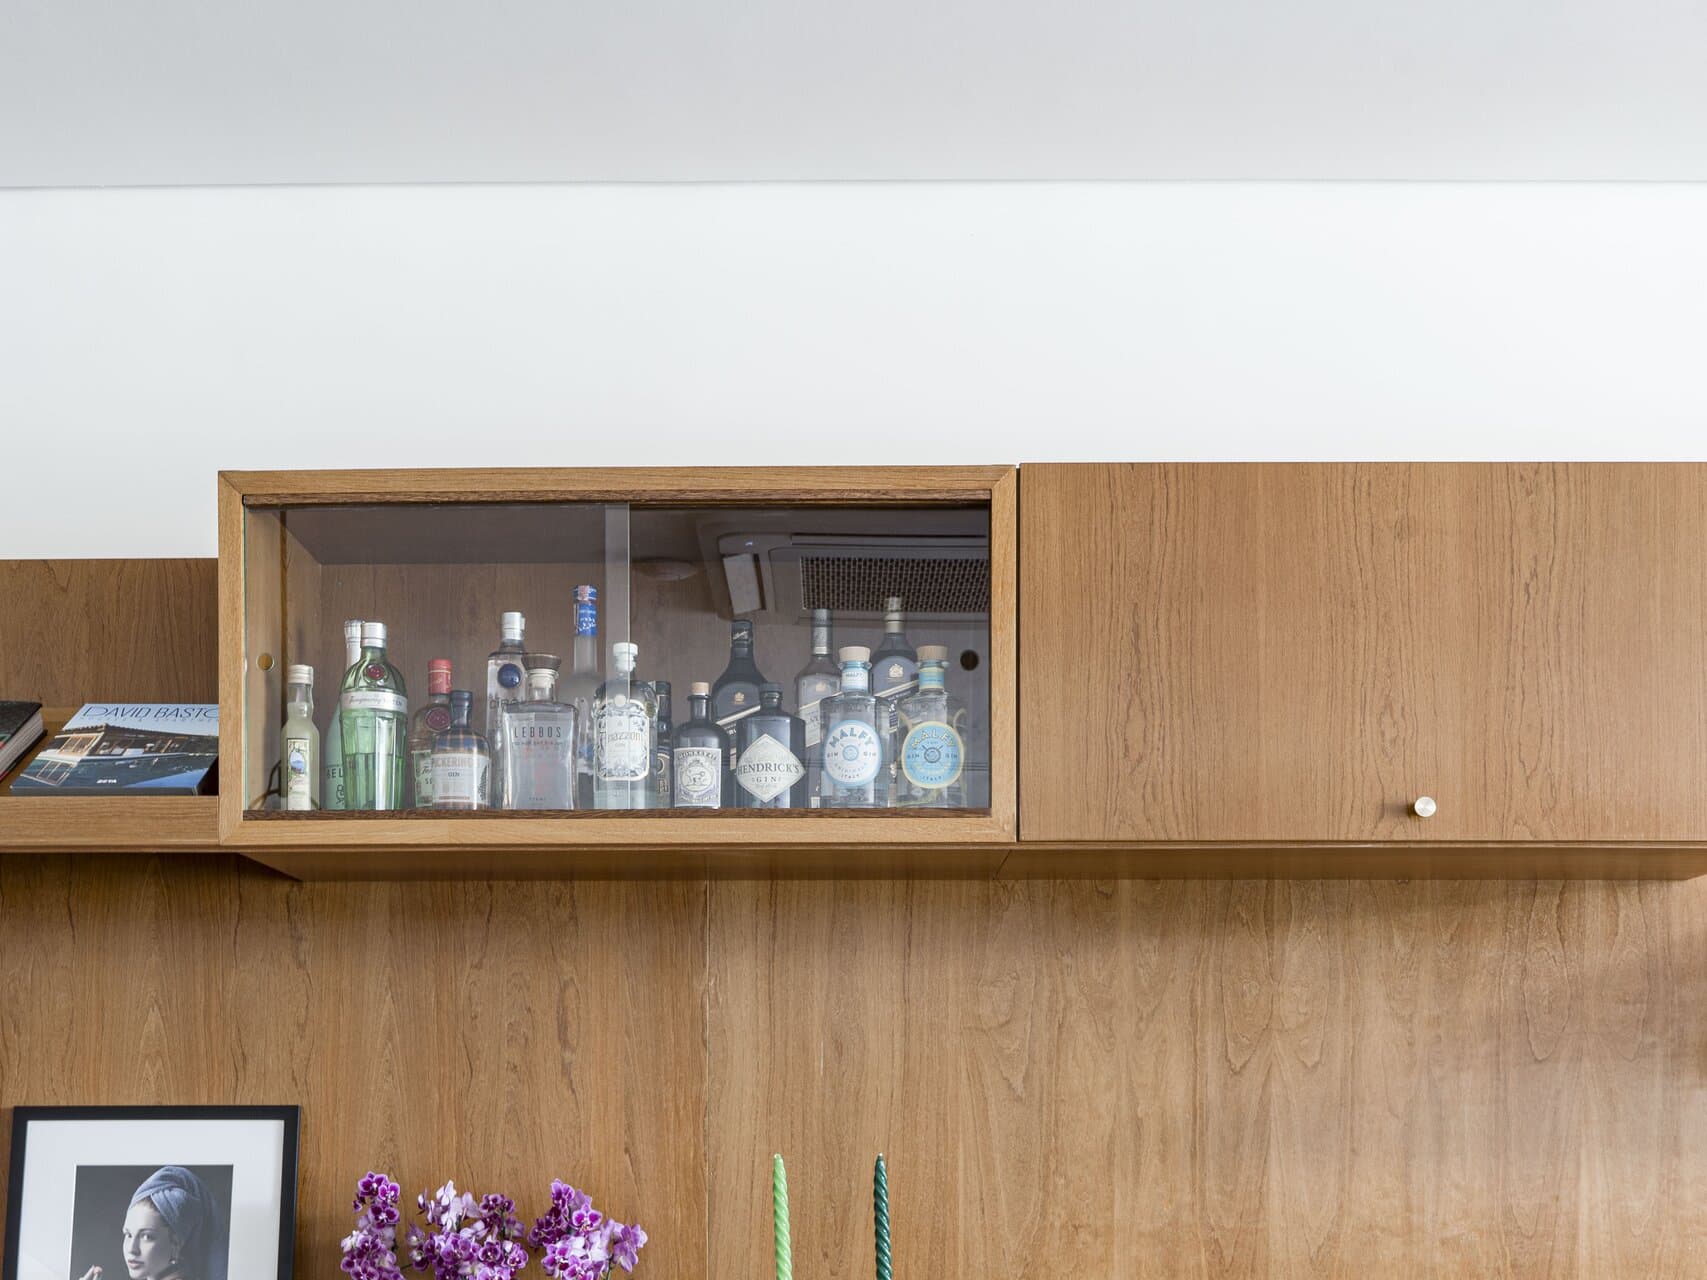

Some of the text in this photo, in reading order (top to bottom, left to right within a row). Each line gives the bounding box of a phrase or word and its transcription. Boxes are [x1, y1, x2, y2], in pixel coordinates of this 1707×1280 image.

[82, 705, 152, 719] DAVID
[829, 727, 875, 749] MALFY
[911, 728, 955, 750] MALFY
[737, 762, 800, 776] HENDRICK'S
